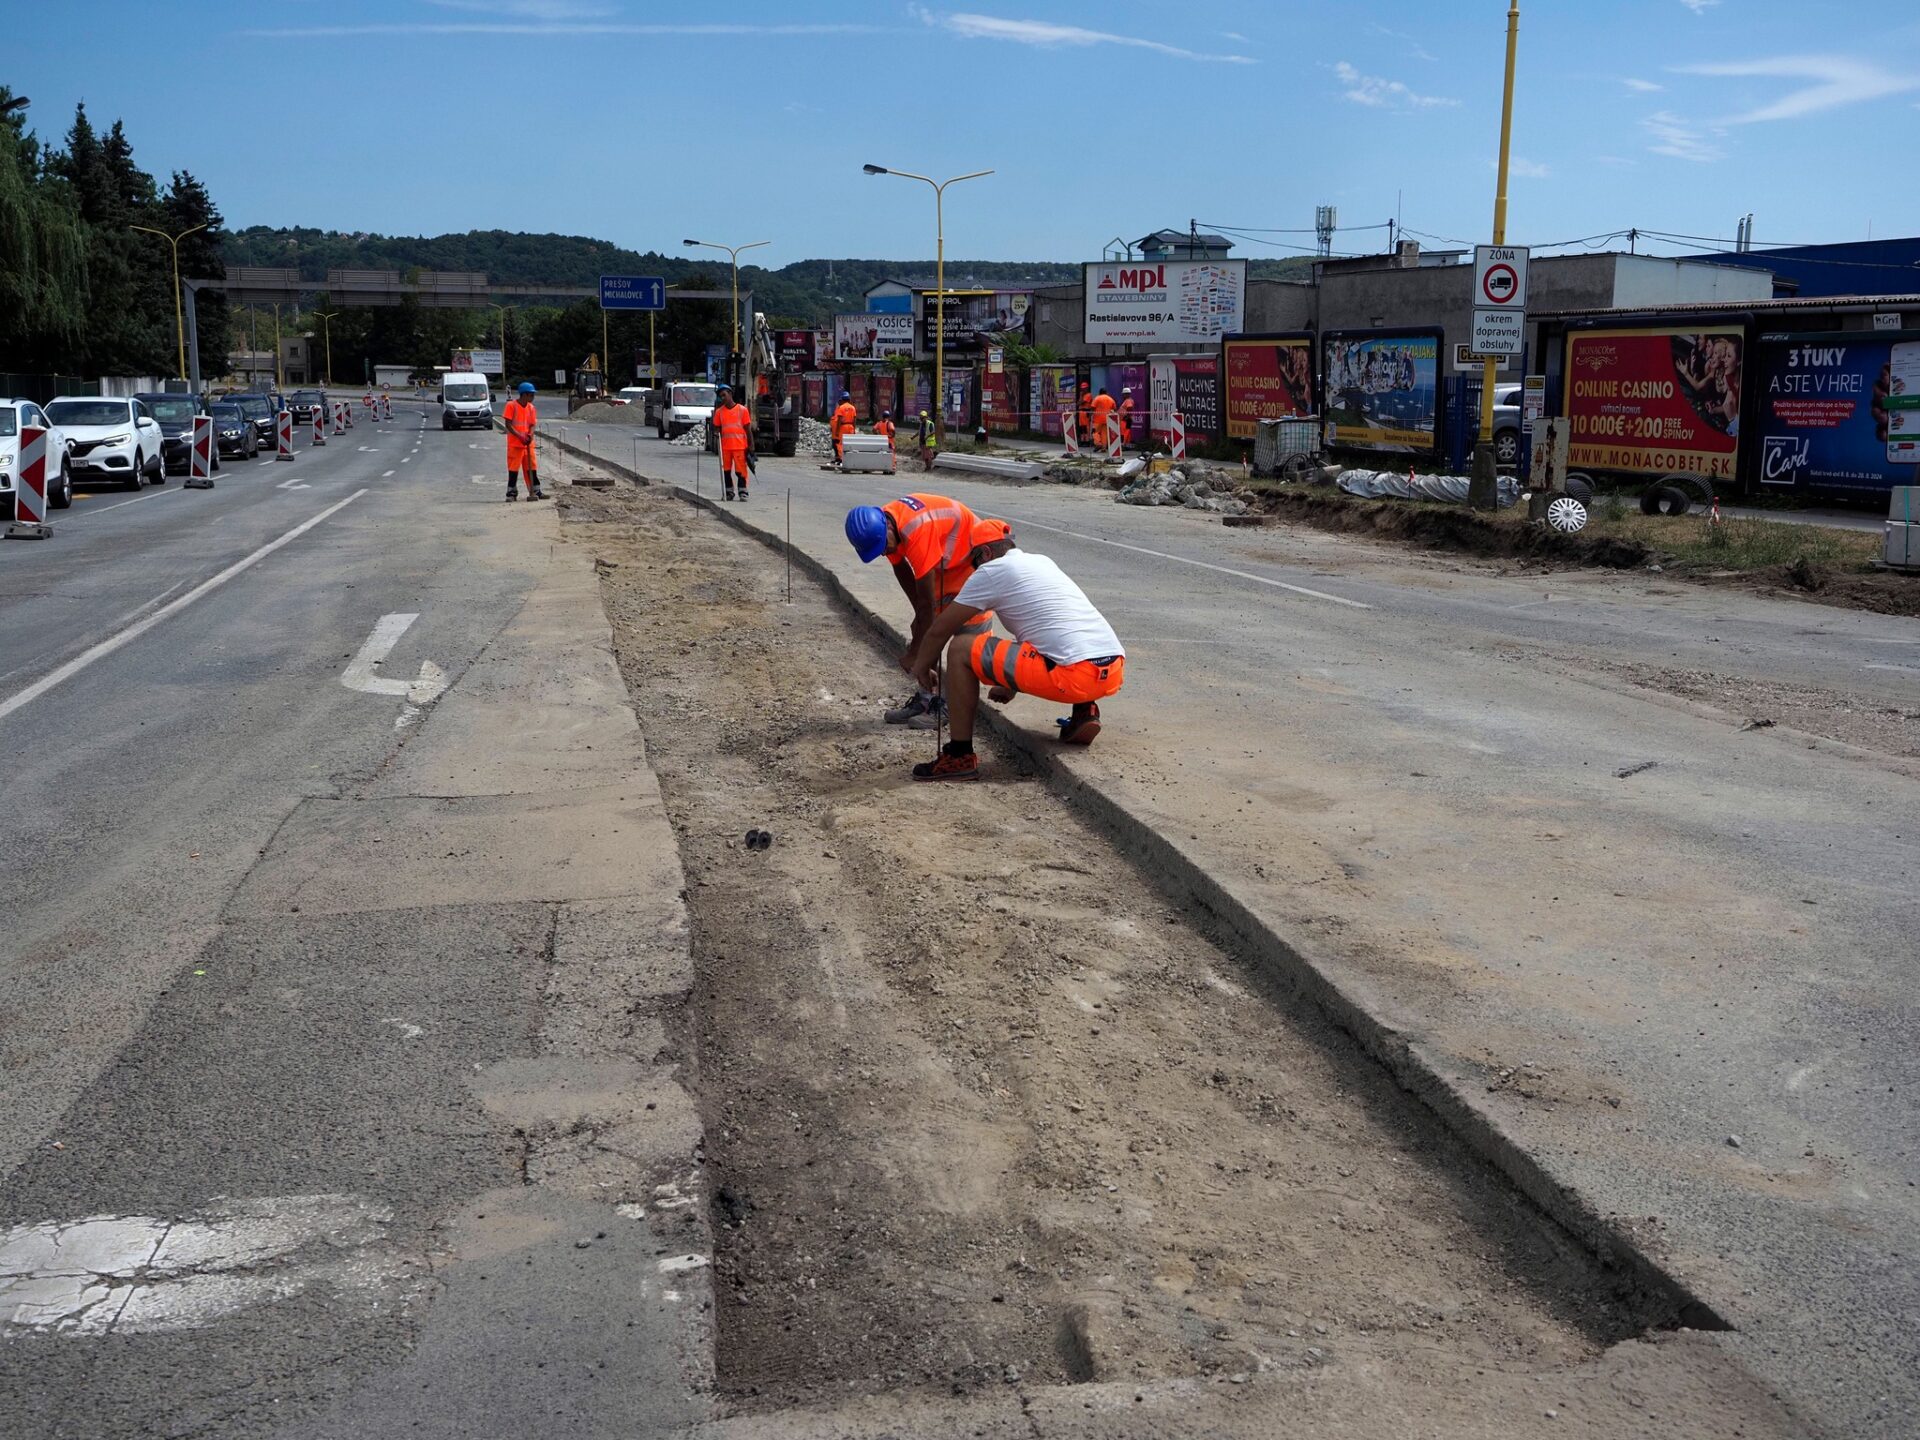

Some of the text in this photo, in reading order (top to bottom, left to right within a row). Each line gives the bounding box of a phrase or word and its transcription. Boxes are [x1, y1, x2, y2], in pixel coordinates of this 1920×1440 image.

[604, 279, 632, 288] PREŠOV
[604, 291, 642, 299] MICHALOVCE
[878, 316, 912, 328] KOŠICE
[1090, 313, 1174, 324] Rastislavova 96/A
[1485, 314, 1512, 324] okrem
[1476, 327, 1520, 338] dopravnej
[1480, 340, 1515, 351] obsluhy
[1788, 344, 1847, 367] 3 ŤUKY
[1152, 368, 1173, 401] inak
[1180, 378, 1216, 394] KUCHYNE
[1230, 376, 1280, 390] ONLINE CASINO
[1574, 380, 1674, 399] ONLINE CASINO
[1769, 374, 1864, 392] A STE V HRE!
[1180, 396, 1216, 412] MATRACE
[1231, 400, 1239, 414] 10
[1184, 413, 1217, 429] OSTELE
[1573, 415, 1588, 434] 10
[1664, 418, 1682, 429] FREE
[1663, 428, 1694, 440] SPINOV
[1570, 448, 1730, 474] WWW.MONACOBET.SK
[1766, 438, 1810, 478] Card
